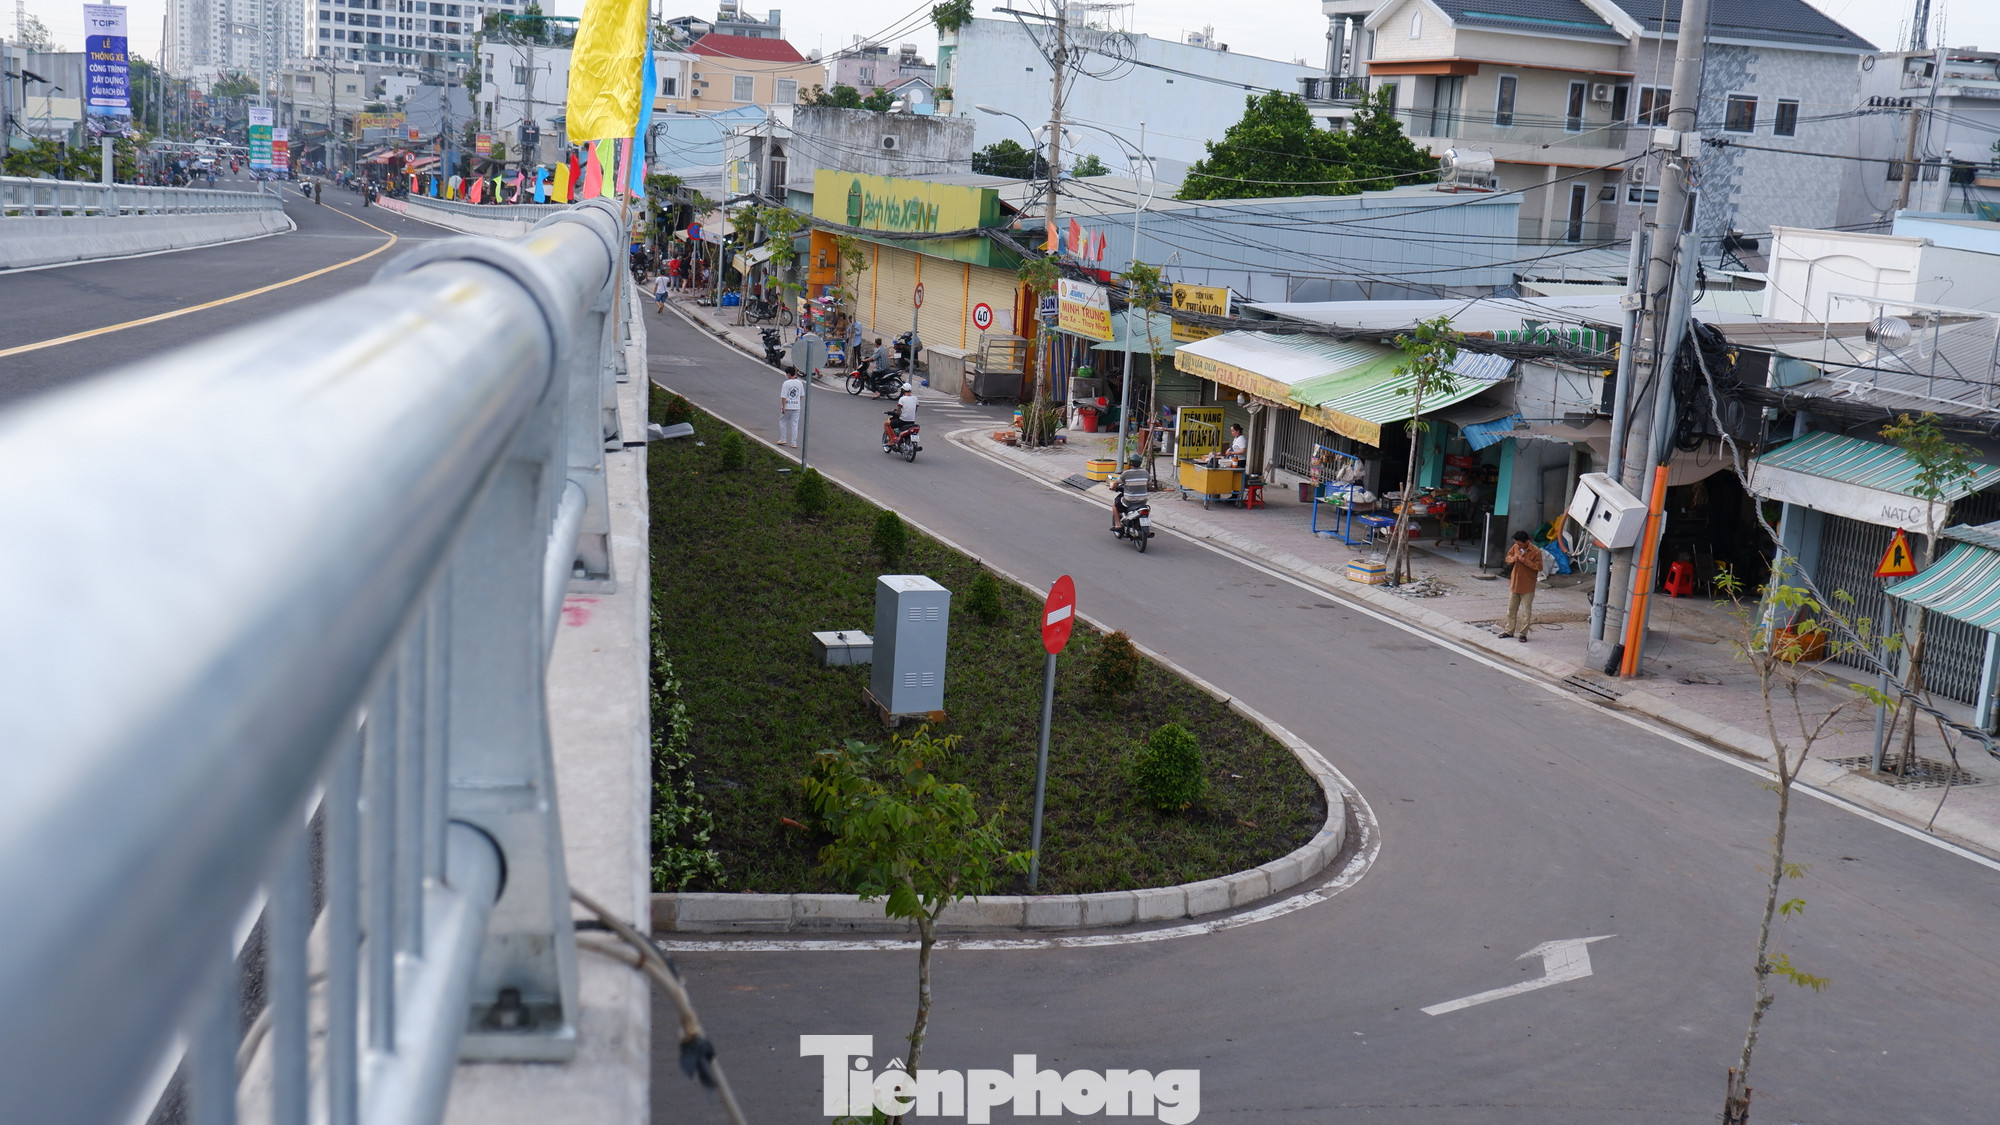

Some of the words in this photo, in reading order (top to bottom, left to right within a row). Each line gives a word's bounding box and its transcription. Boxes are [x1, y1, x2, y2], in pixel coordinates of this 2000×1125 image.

[91, 19, 115, 27] TCIP
[90, 51, 114, 61] THÔNG
[115, 53, 124, 62] XE
[89, 63, 106, 72] CÔNG
[107, 64, 127, 74] TRÌNH
[900, 198, 940, 233] XANH
[977, 310, 988, 322] 40
[1062, 302, 1080, 316] MINH
[1082, 307, 1106, 323] TRUNG
[1215, 367, 1234, 384] GIA
[1203, 410, 1222, 423] VÀNG
